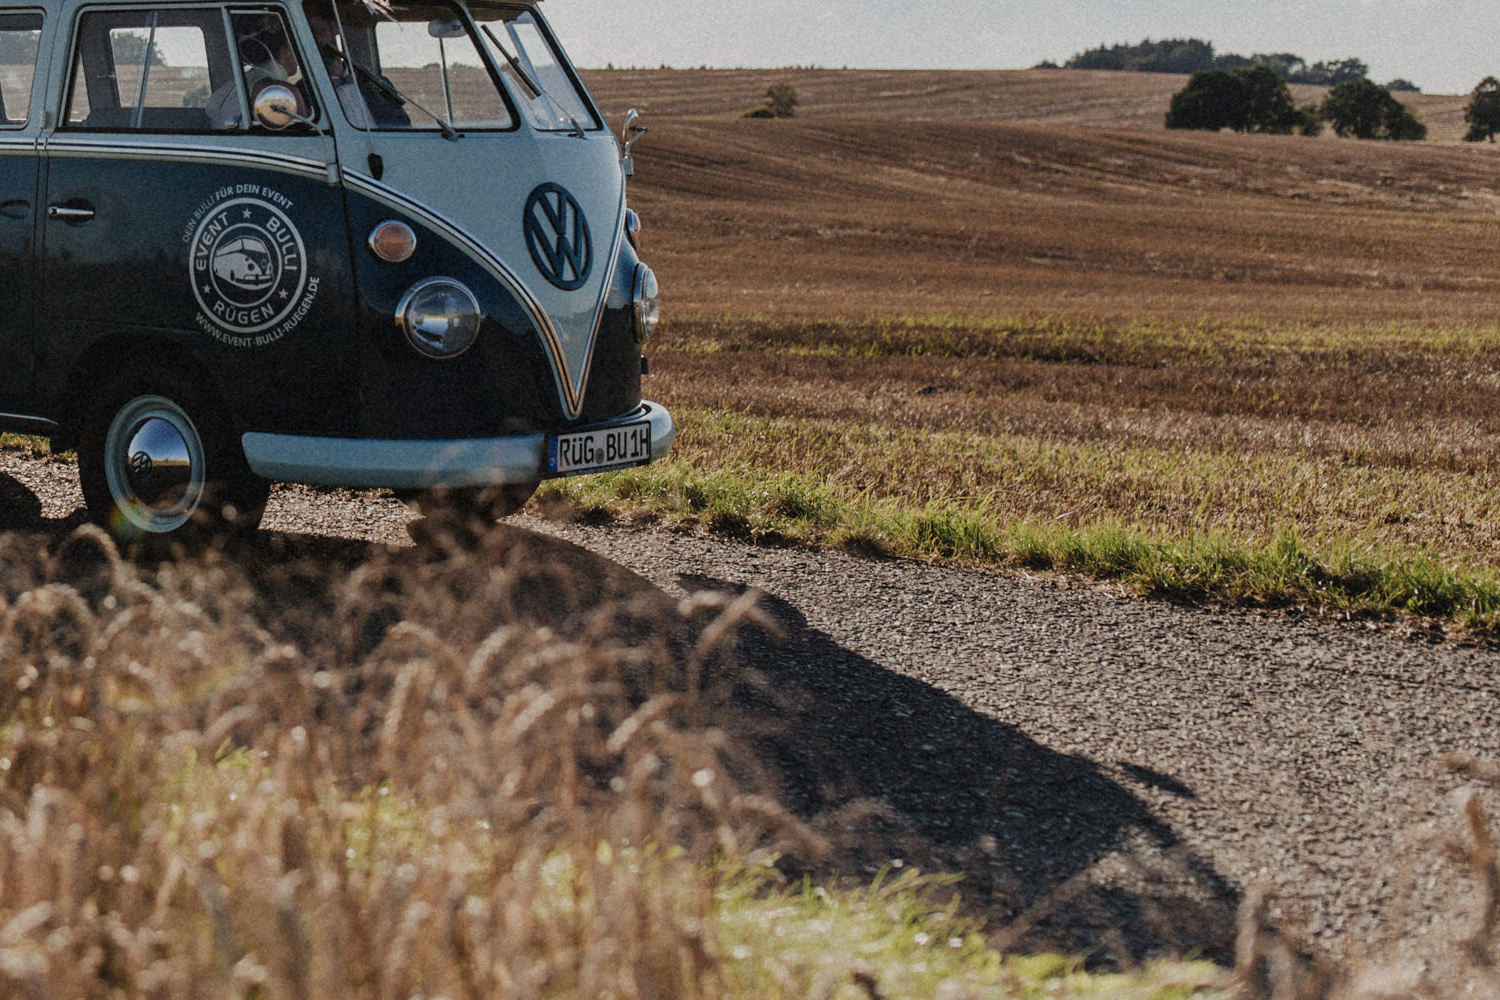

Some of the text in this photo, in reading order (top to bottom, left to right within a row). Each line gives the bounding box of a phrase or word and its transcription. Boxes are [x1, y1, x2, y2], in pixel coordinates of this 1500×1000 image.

[182, 183, 294, 244] DEIN BULLI FÜR DEIN EVENT
[195, 211, 298, 271] EVENT BULLI
[523, 182, 593, 291] VW
[195, 275, 320, 347] WWW.EVENT-BULLI-RUEGEN.DE
[212, 300, 276, 325] RÜGEN
[560, 435, 595, 467] RÜG
[607, 432, 627, 461] BU
[630, 427, 649, 458] 1H
